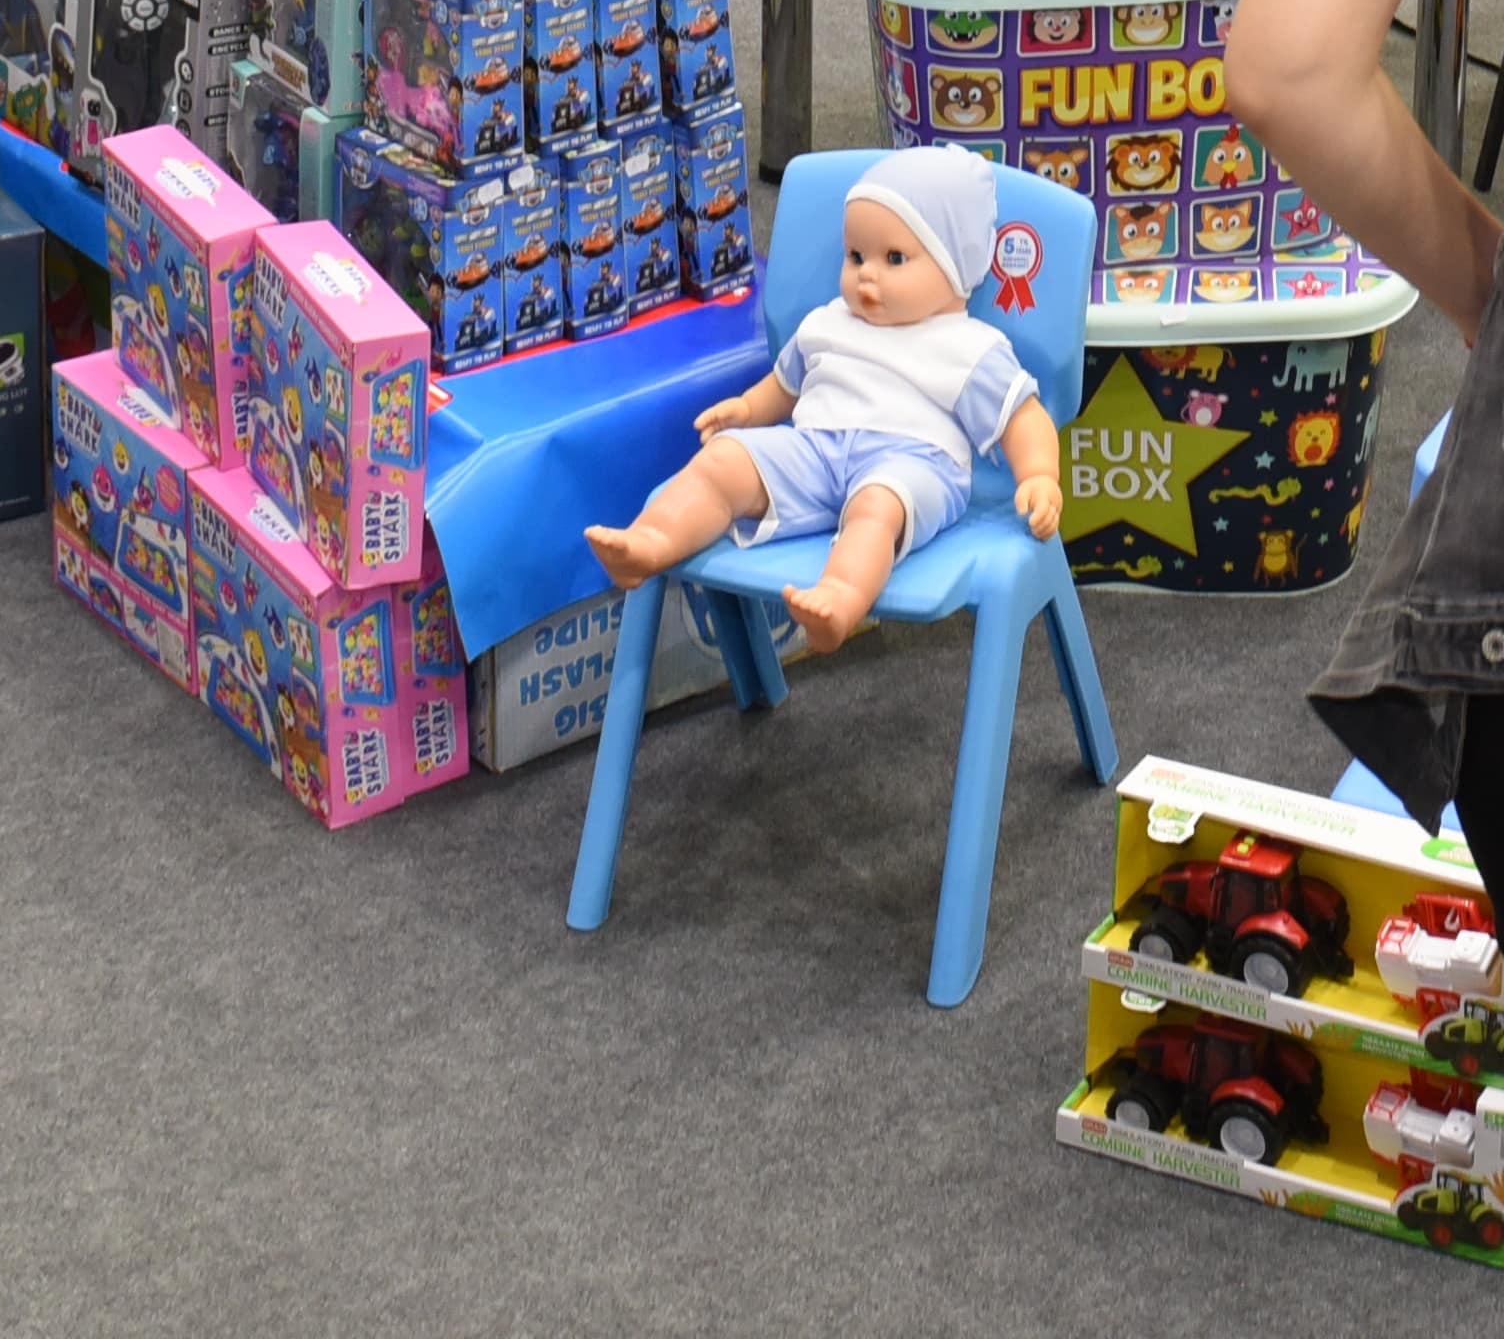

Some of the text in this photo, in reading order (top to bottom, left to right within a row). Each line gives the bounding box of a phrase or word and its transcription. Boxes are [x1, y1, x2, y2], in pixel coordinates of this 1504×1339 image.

[1019, 57, 1230, 126] FUN BO
[58, 406, 100, 456] SHARK
[66, 393, 96, 428] BABY
[1070, 427, 1173, 465] FUN
[1070, 465, 1173, 502] BOX
[365, 501, 382, 553] BABY
[384, 491, 402, 564] SHARK
[519, 650, 617, 707] LASH
[416, 712, 431, 764] BABY
[434, 697, 448, 766] SHARK
[345, 740, 362, 792] BABY
[365, 730, 380, 796] SHARK
[1108, 966, 1268, 1021] COMBINE HARVESTER
[1081, 1131, 1241, 1190] COMBINE HARVESTER
